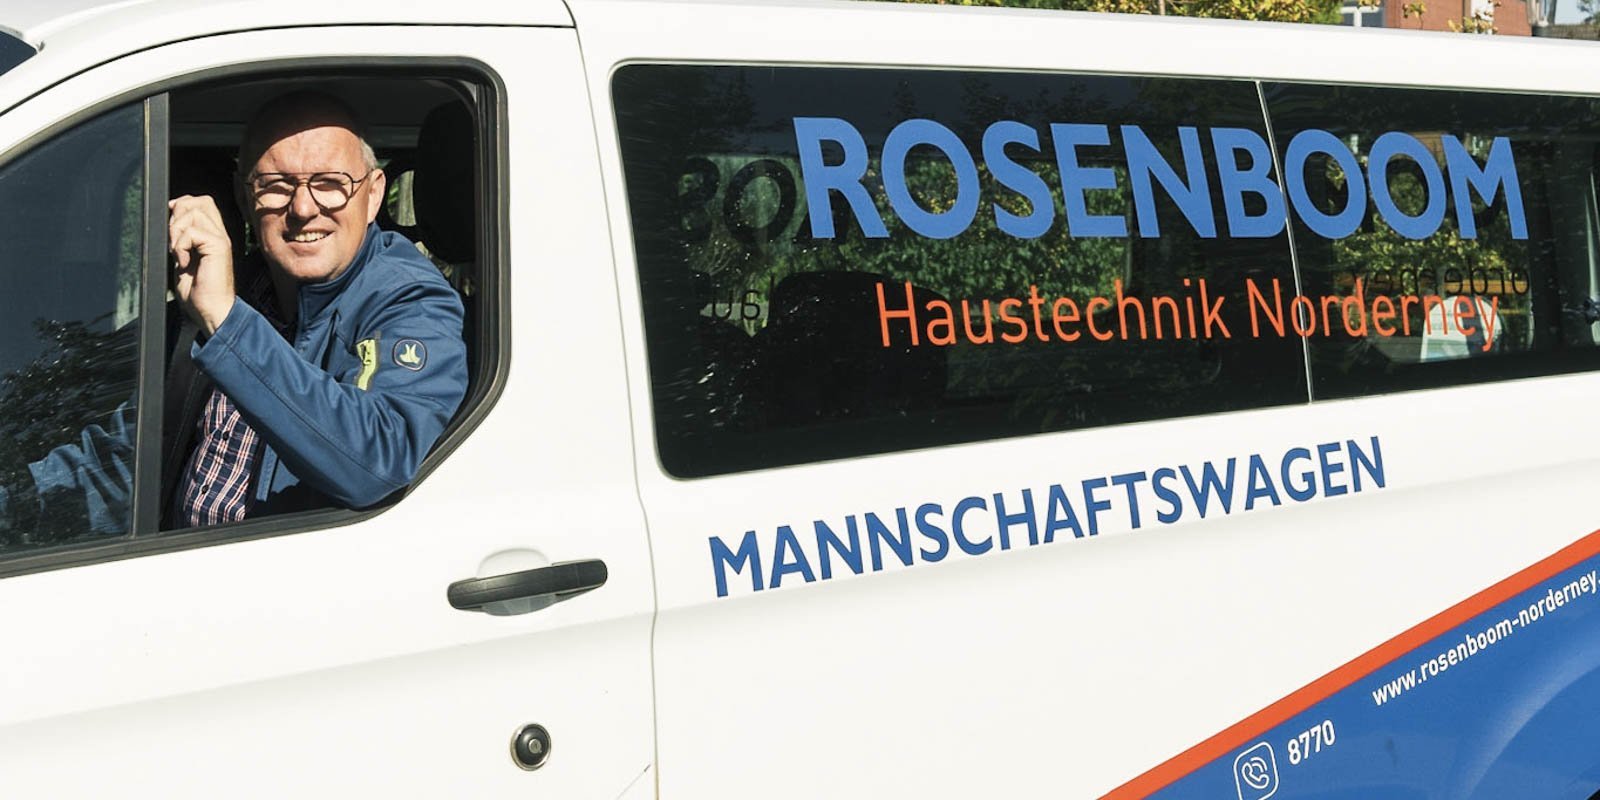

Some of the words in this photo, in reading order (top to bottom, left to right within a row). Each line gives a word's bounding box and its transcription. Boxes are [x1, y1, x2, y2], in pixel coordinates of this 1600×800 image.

[794, 117, 1528, 240] ROSENBOOM
[876, 278, 1231, 347] Haustechnik
[1246, 277, 1499, 352] Norderney
[708, 436, 1385, 597] MANNSCHAFTSWAGEN
[1287, 719, 1336, 766] 8770
